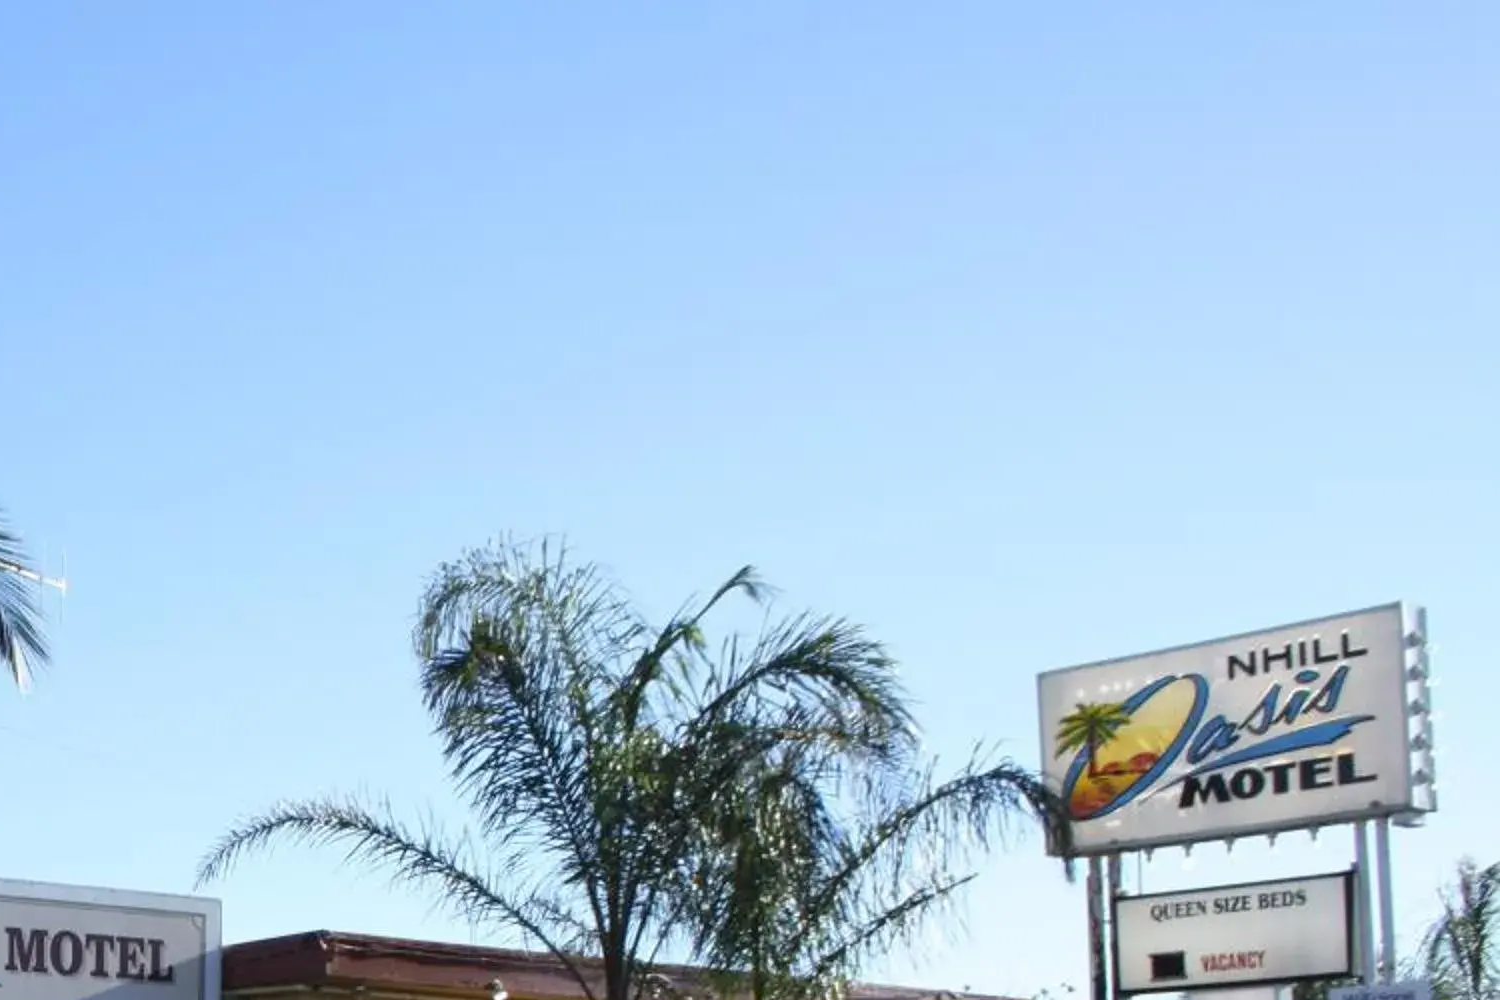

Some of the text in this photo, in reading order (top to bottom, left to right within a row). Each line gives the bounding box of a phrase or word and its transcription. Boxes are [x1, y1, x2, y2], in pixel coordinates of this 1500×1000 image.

[1228, 632, 1368, 680] NHILL
[1062, 665, 1350, 820] Oasis
[1179, 753, 1377, 809] MOTEL
[1150, 889, 1307, 922] QUEEN SIZE BEDS
[4, 926, 173, 983] MOTEL
[1201, 950, 1266, 972] VACANCY
